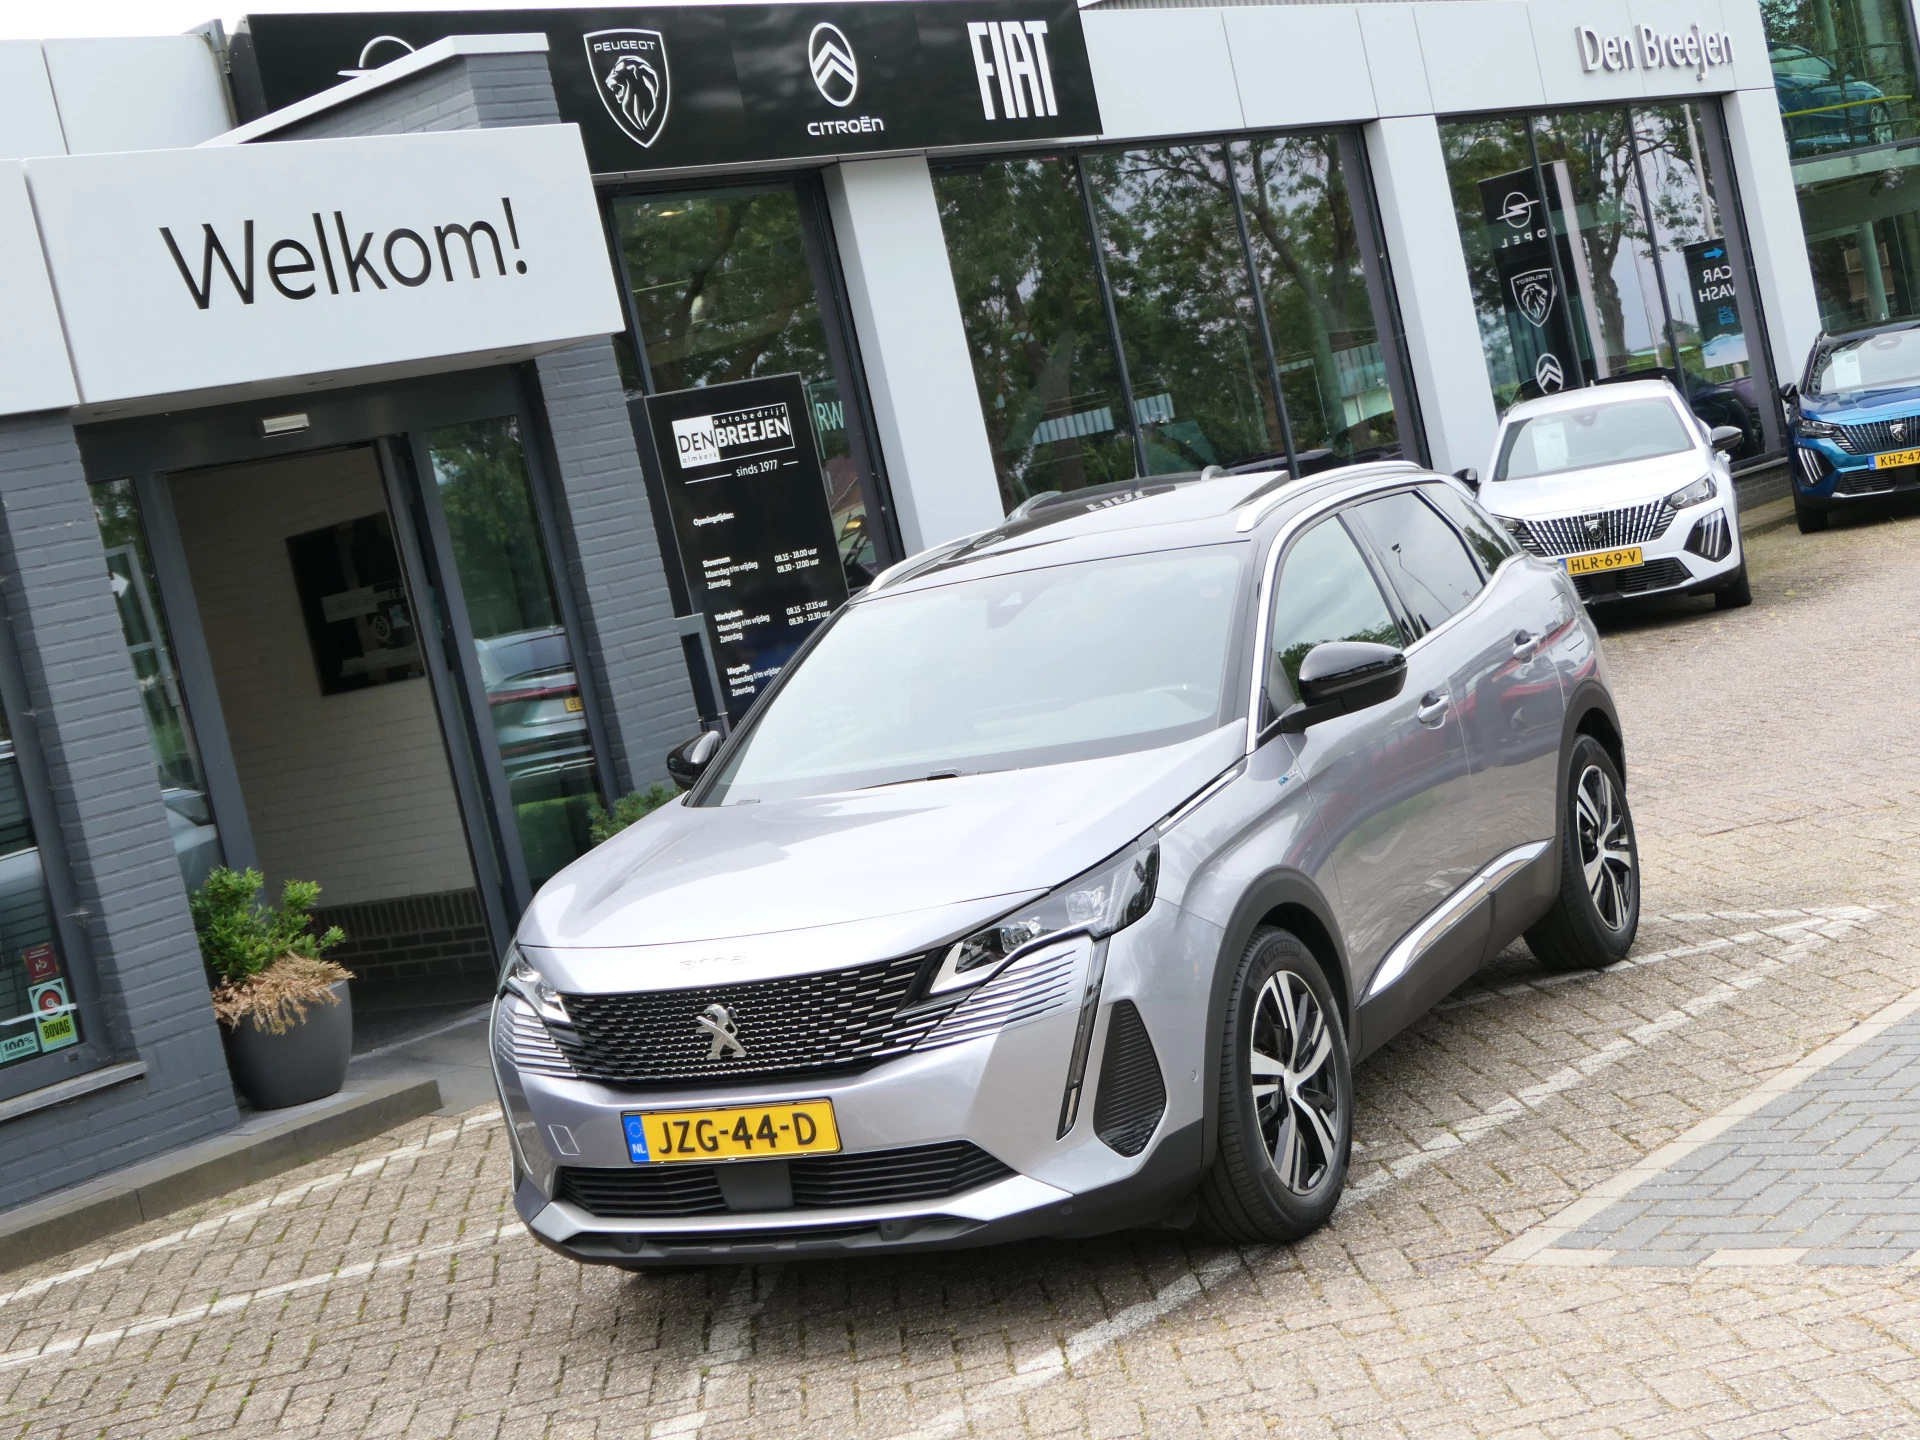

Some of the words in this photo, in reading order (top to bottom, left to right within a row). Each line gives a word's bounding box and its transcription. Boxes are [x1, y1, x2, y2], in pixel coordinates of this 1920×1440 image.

[593, 40, 655, 53] PEUGEOT
[1575, 25, 1635, 72] Den
[1634, 21, 1736, 81] Breejen
[967, 20, 1058, 120] FIAT
[807, 116, 885, 137] CITROËN
[159, 197, 528, 310] Welkom!
[713, 405, 785, 425] autobedrijf
[678, 430, 716, 453] DEN
[715, 416, 790, 448] BREEJEN
[682, 452, 718, 464] almkerk
[736, 464, 758, 477] sinds
[759, 459, 778, 473] 1977
[702, 556, 731, 568] Showroom
[705, 567, 730, 578] Maandag
[730, 565, 740, 573] t/m
[740, 561, 758, 571] vrijdag
[1571, 550, 1636, 572] HLR-69-V
[707, 579, 731, 590] Zaterdag
[809, 558, 819, 566] uur
[714, 609, 744, 621] Werkplaats
[717, 621, 742, 632] Maandag
[742, 618, 752, 627] t/m
[752, 614, 770, 624] vrijdag
[719, 632, 743, 643] Zaterdag
[729, 674, 754, 685] Maandag
[753, 671, 764, 679] t/m
[731, 685, 755, 696] Zaterdag
[42, 1020, 70, 1040] BOVAG
[632, 1143, 646, 1154] NL
[658, 1112, 817, 1154] JZG-44-D
